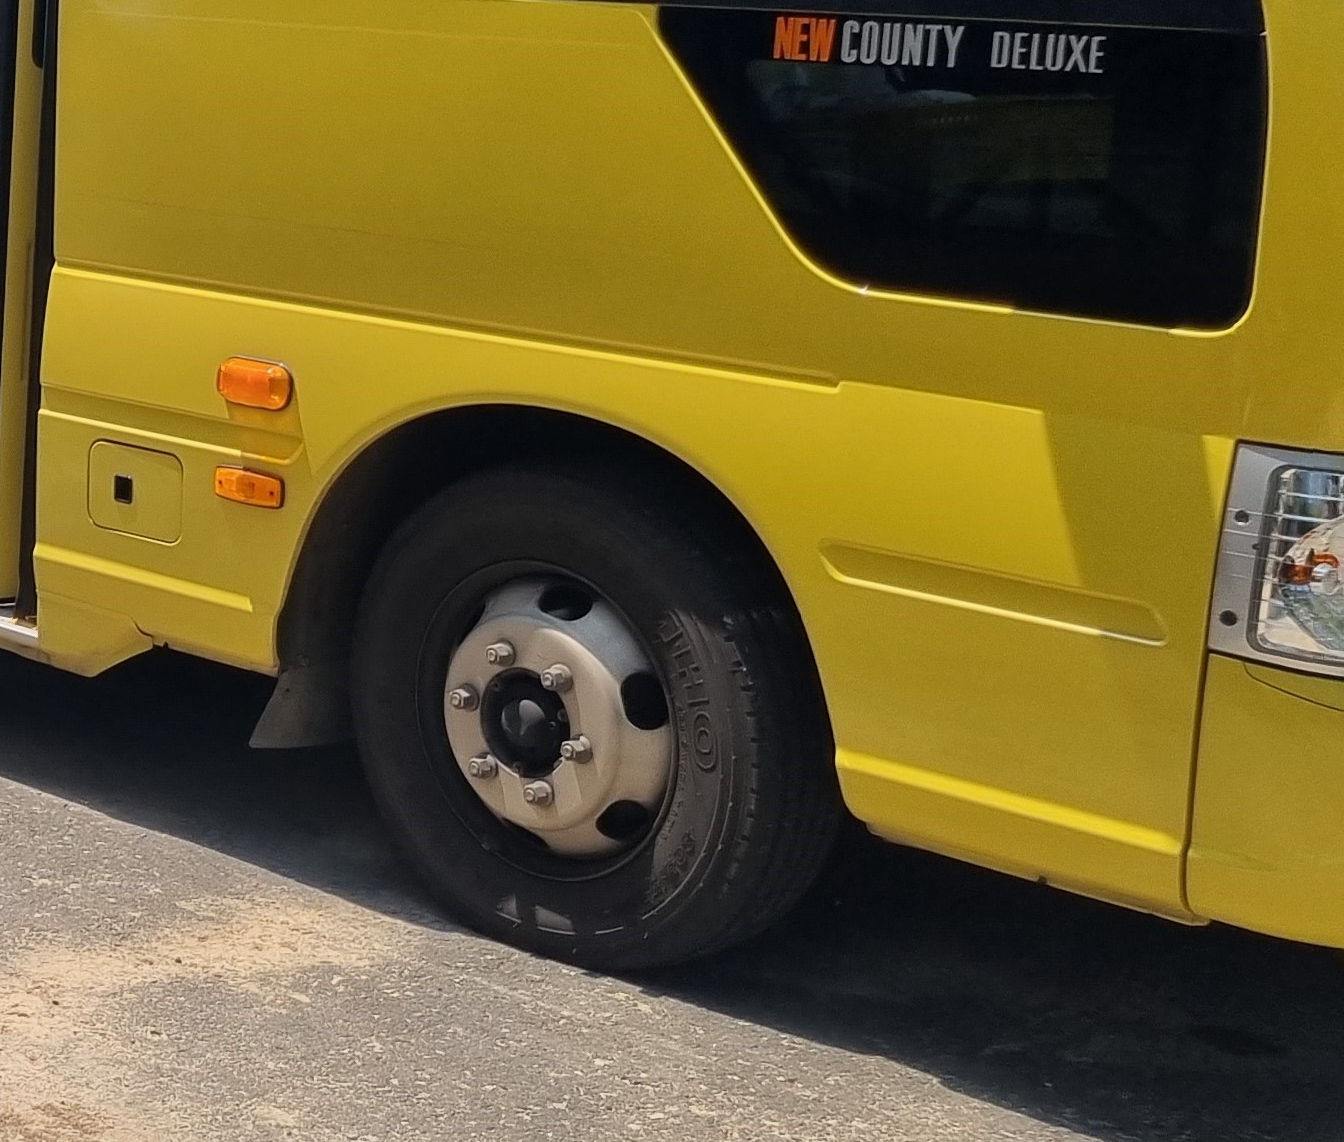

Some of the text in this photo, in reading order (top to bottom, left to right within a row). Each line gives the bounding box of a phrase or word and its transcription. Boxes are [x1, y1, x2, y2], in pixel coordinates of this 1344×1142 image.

[773, 16, 1107, 74] NEW COUNTY DELUXE
